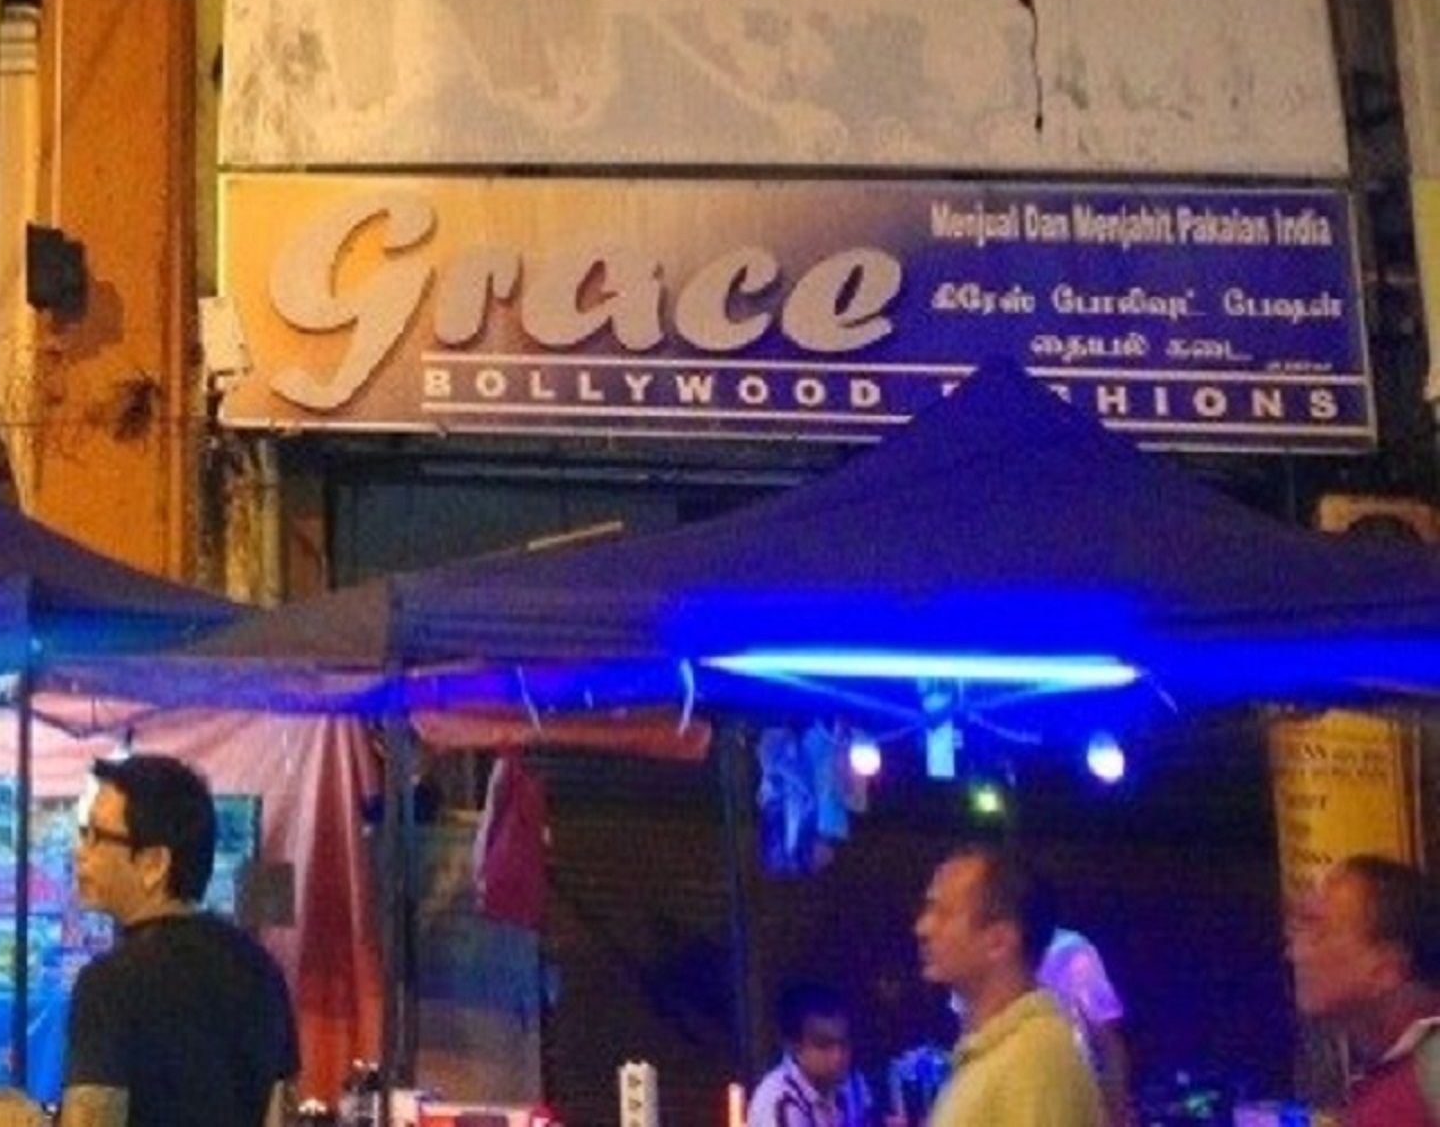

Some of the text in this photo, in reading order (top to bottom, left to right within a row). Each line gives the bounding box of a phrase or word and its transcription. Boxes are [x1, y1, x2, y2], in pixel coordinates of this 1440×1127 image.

[930, 200, 1333, 252] Menjual Dan Menjahit Pakaian India
[268, 191, 900, 411] Grace
[424, 369, 1339, 419] BOLLYWOOD HIONS
